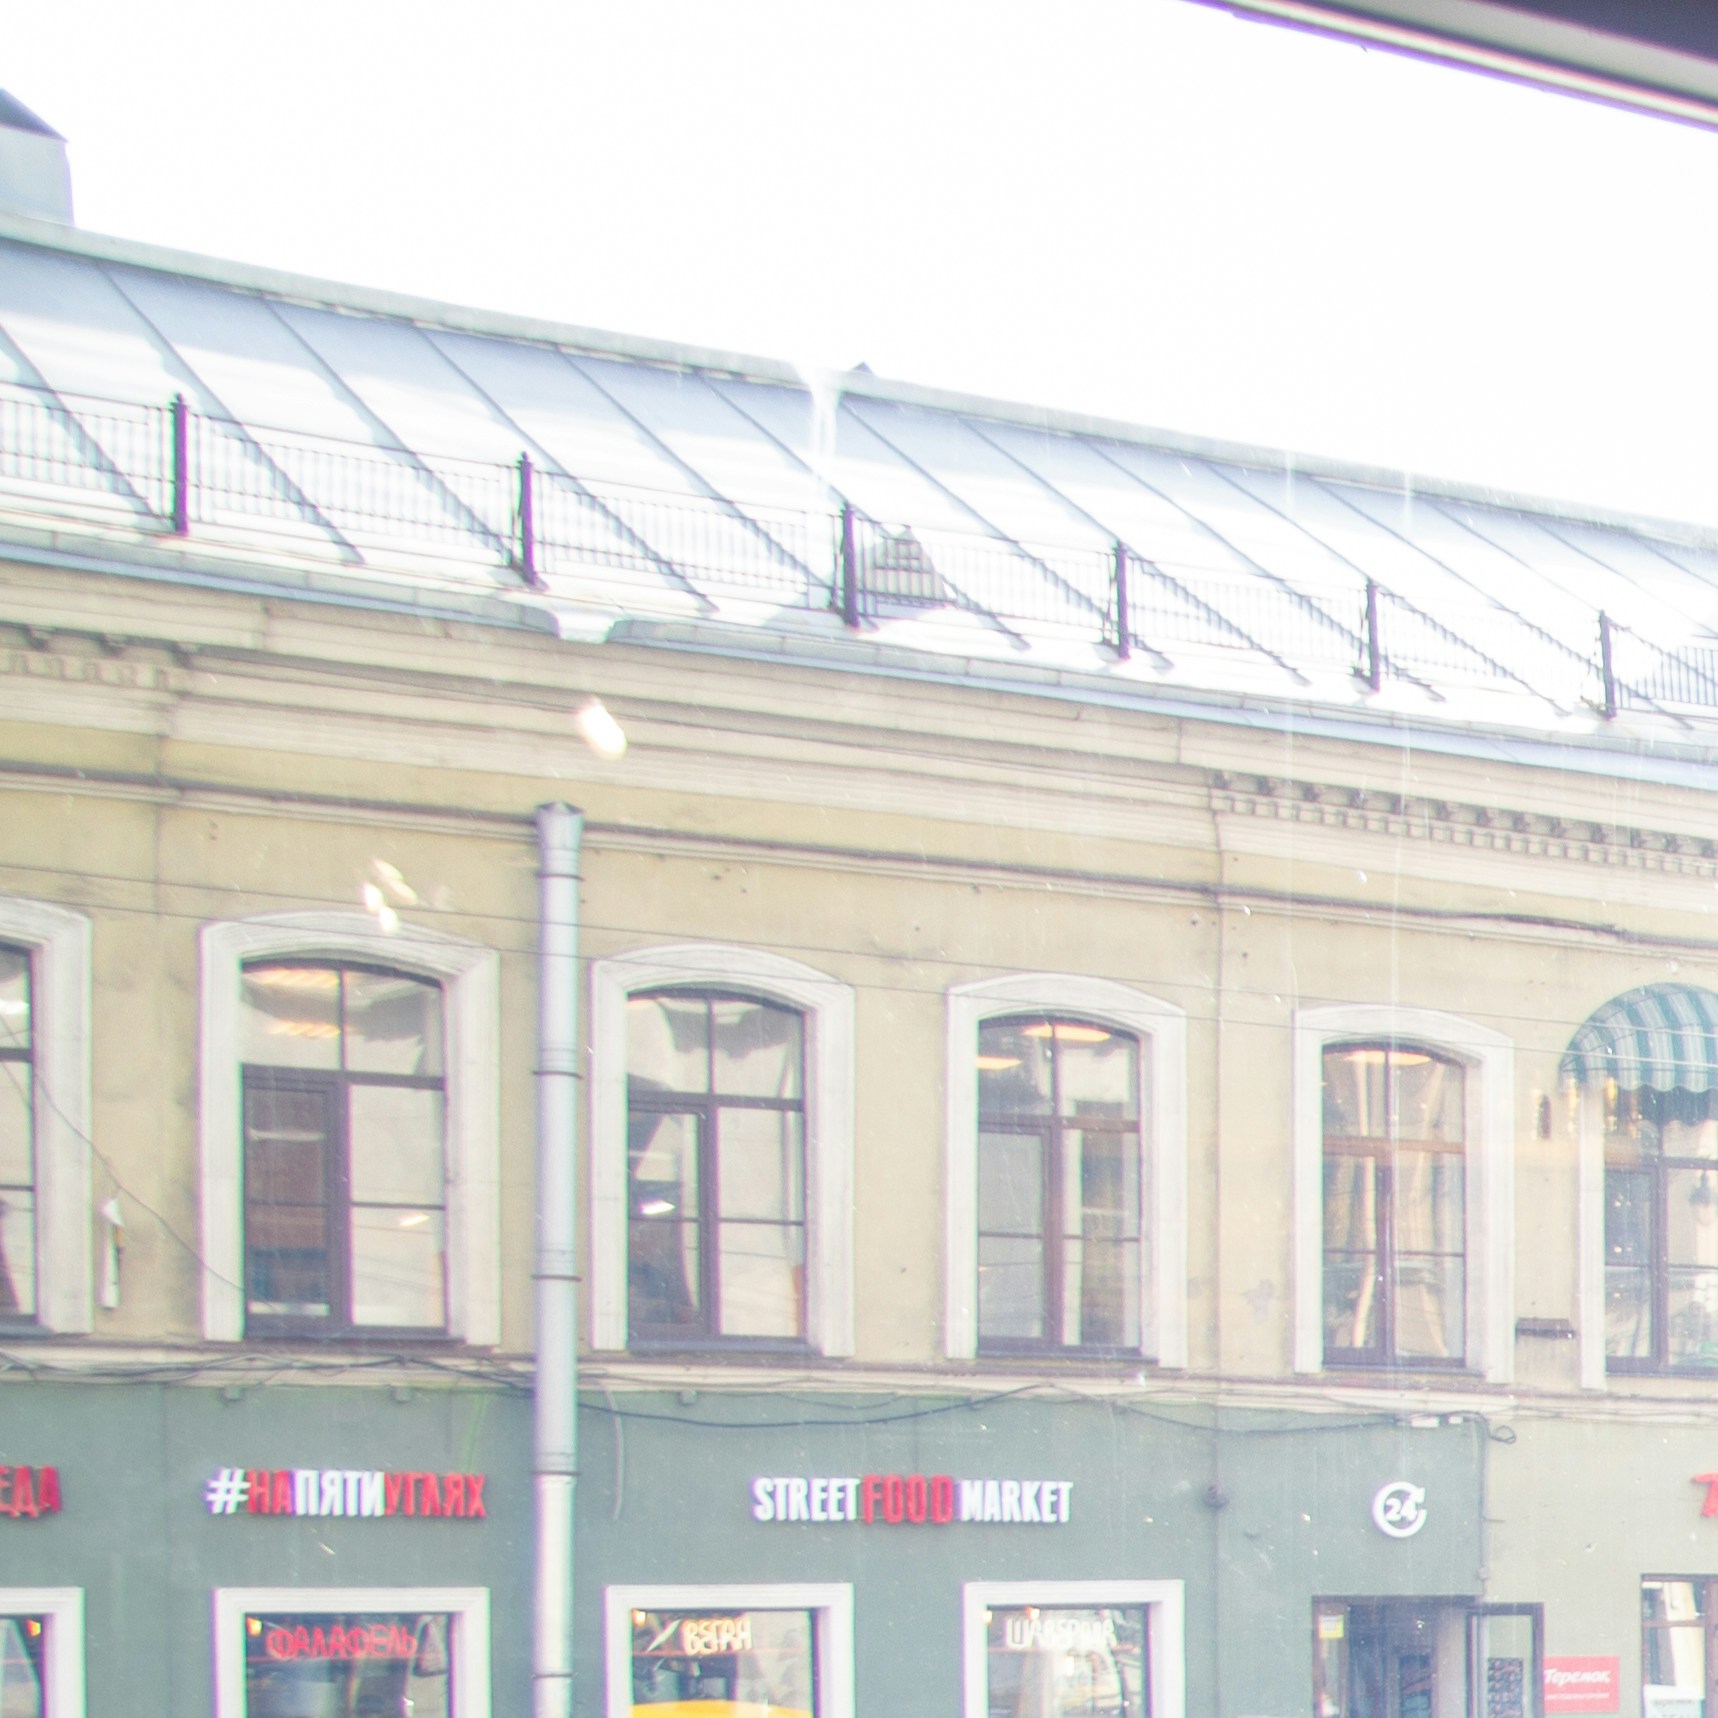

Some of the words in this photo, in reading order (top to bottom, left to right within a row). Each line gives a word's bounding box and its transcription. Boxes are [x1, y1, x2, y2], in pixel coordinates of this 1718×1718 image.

[752, 1476, 861, 1522] STREET
[862, 1474, 955, 1525] FOOD
[957, 1479, 1074, 1523] MARKET
[1384, 1496, 1418, 1521] 24
[267, 1624, 419, 1660] ФАЛАФЕЛЬ
[682, 1617, 752, 1655] ВЕГАН
